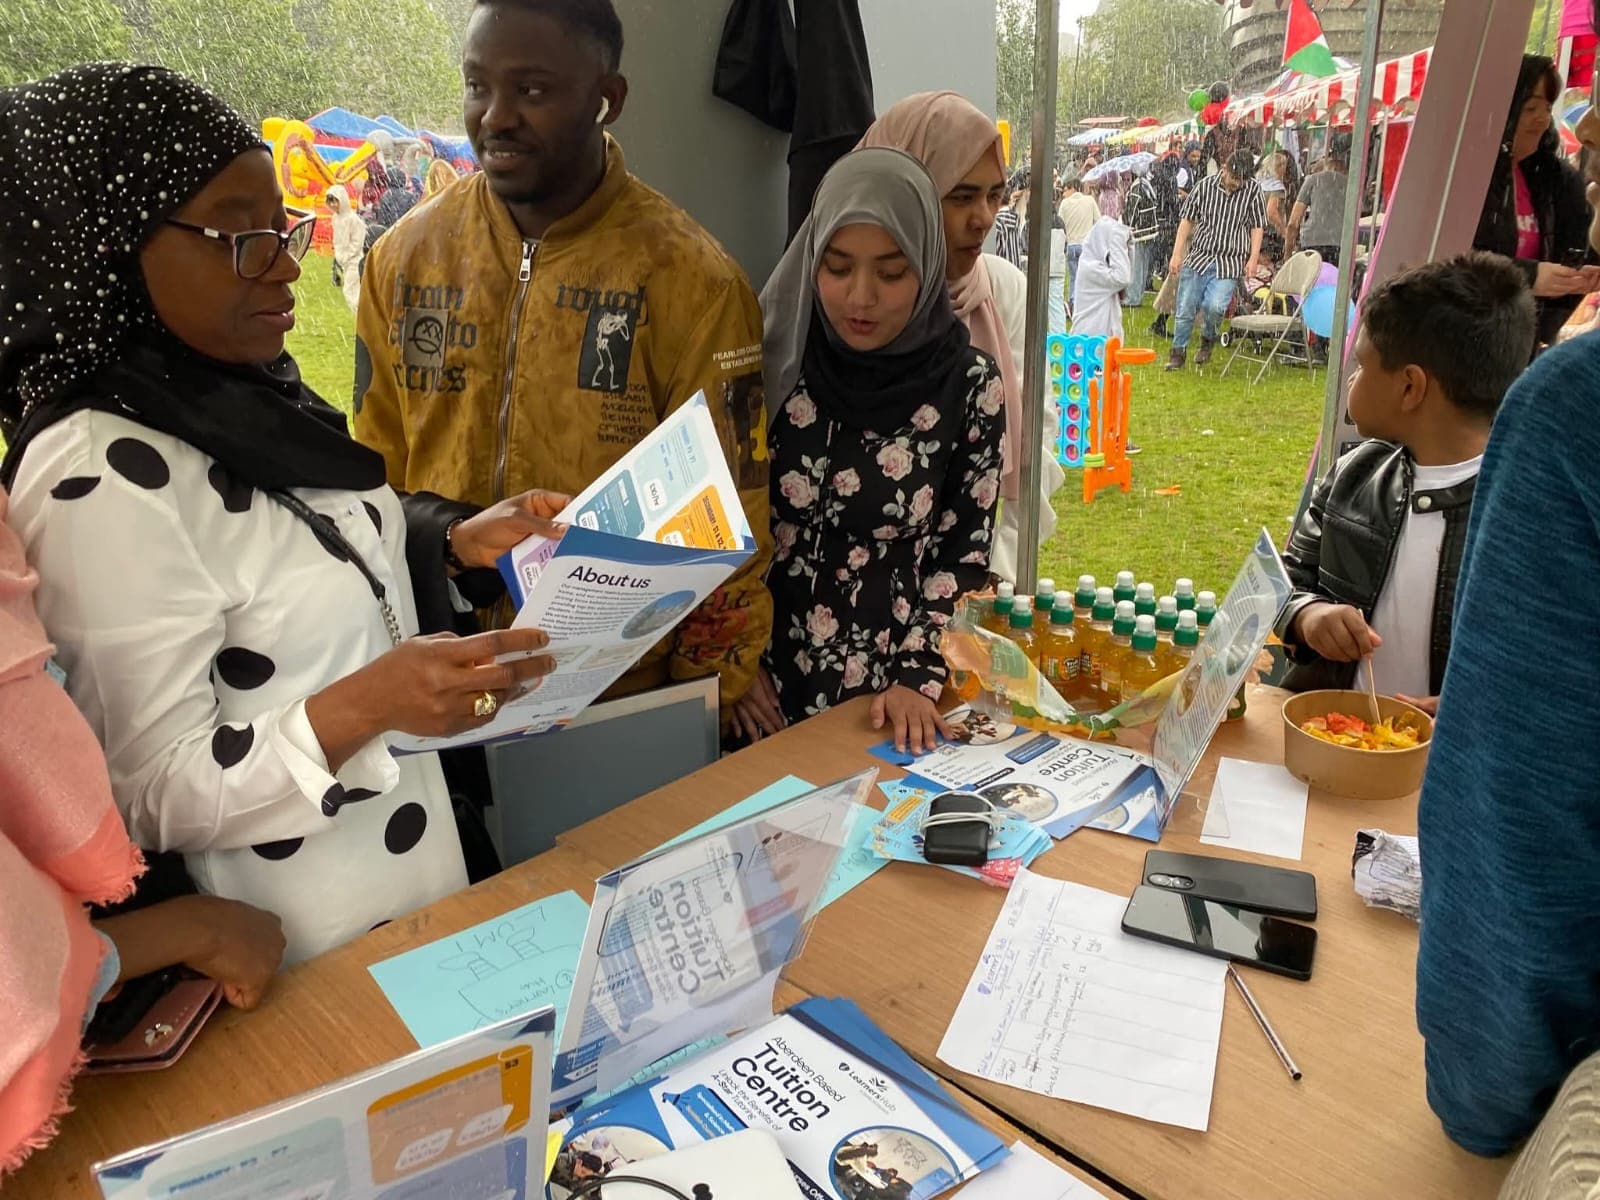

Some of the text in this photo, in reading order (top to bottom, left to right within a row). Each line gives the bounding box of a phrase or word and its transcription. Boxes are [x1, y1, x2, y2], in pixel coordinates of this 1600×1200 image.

[567, 566, 651, 588] About us
[1039, 748, 1093, 776] Centre
[1054, 754, 1111, 782] Tuition
[754, 1042, 830, 1119] Tuition
[773, 1036, 815, 1078] Aberdeen
[813, 1074, 846, 1103] Based
[732, 1057, 809, 1132] Centre
